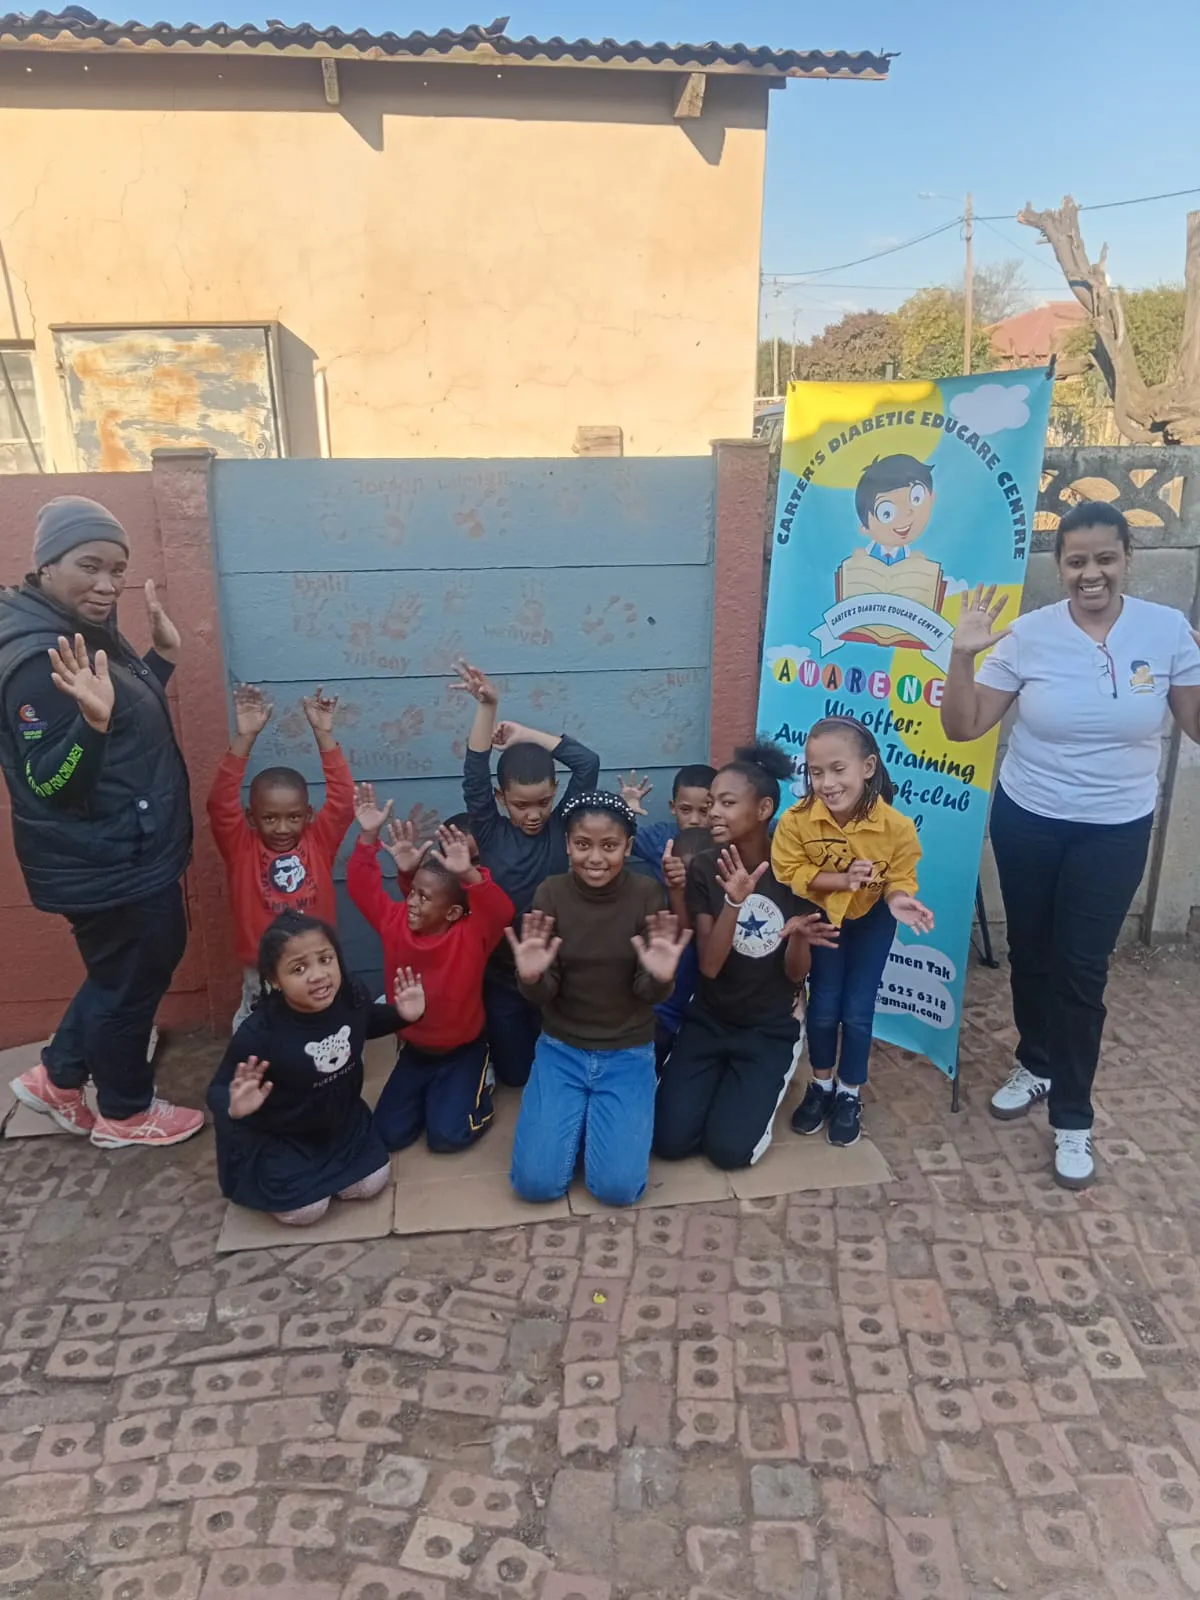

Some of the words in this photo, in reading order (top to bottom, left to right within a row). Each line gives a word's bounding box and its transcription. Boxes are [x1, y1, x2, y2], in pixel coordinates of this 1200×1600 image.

[777, 452, 826, 545] CARTER'S
[827, 409, 915, 454] DIABETIC
[919, 411, 1001, 472] EDUCARE
[997, 471, 1027, 560] CENTRE
[831, 607, 857, 626] CARTER'S
[857, 604, 887, 613] DIABETIC
[887, 605, 918, 622] EDUCARE
[917, 617, 945, 639] CENTRE
[778, 658, 945, 706] AWARENE
[860, 711, 923, 735] offer:
[885, 744, 975, 784] Training
[889, 952, 923, 970] men
[926, 960, 950, 980] Tak
[888, 983, 914, 998] 625
[917, 991, 947, 1011] 6318
